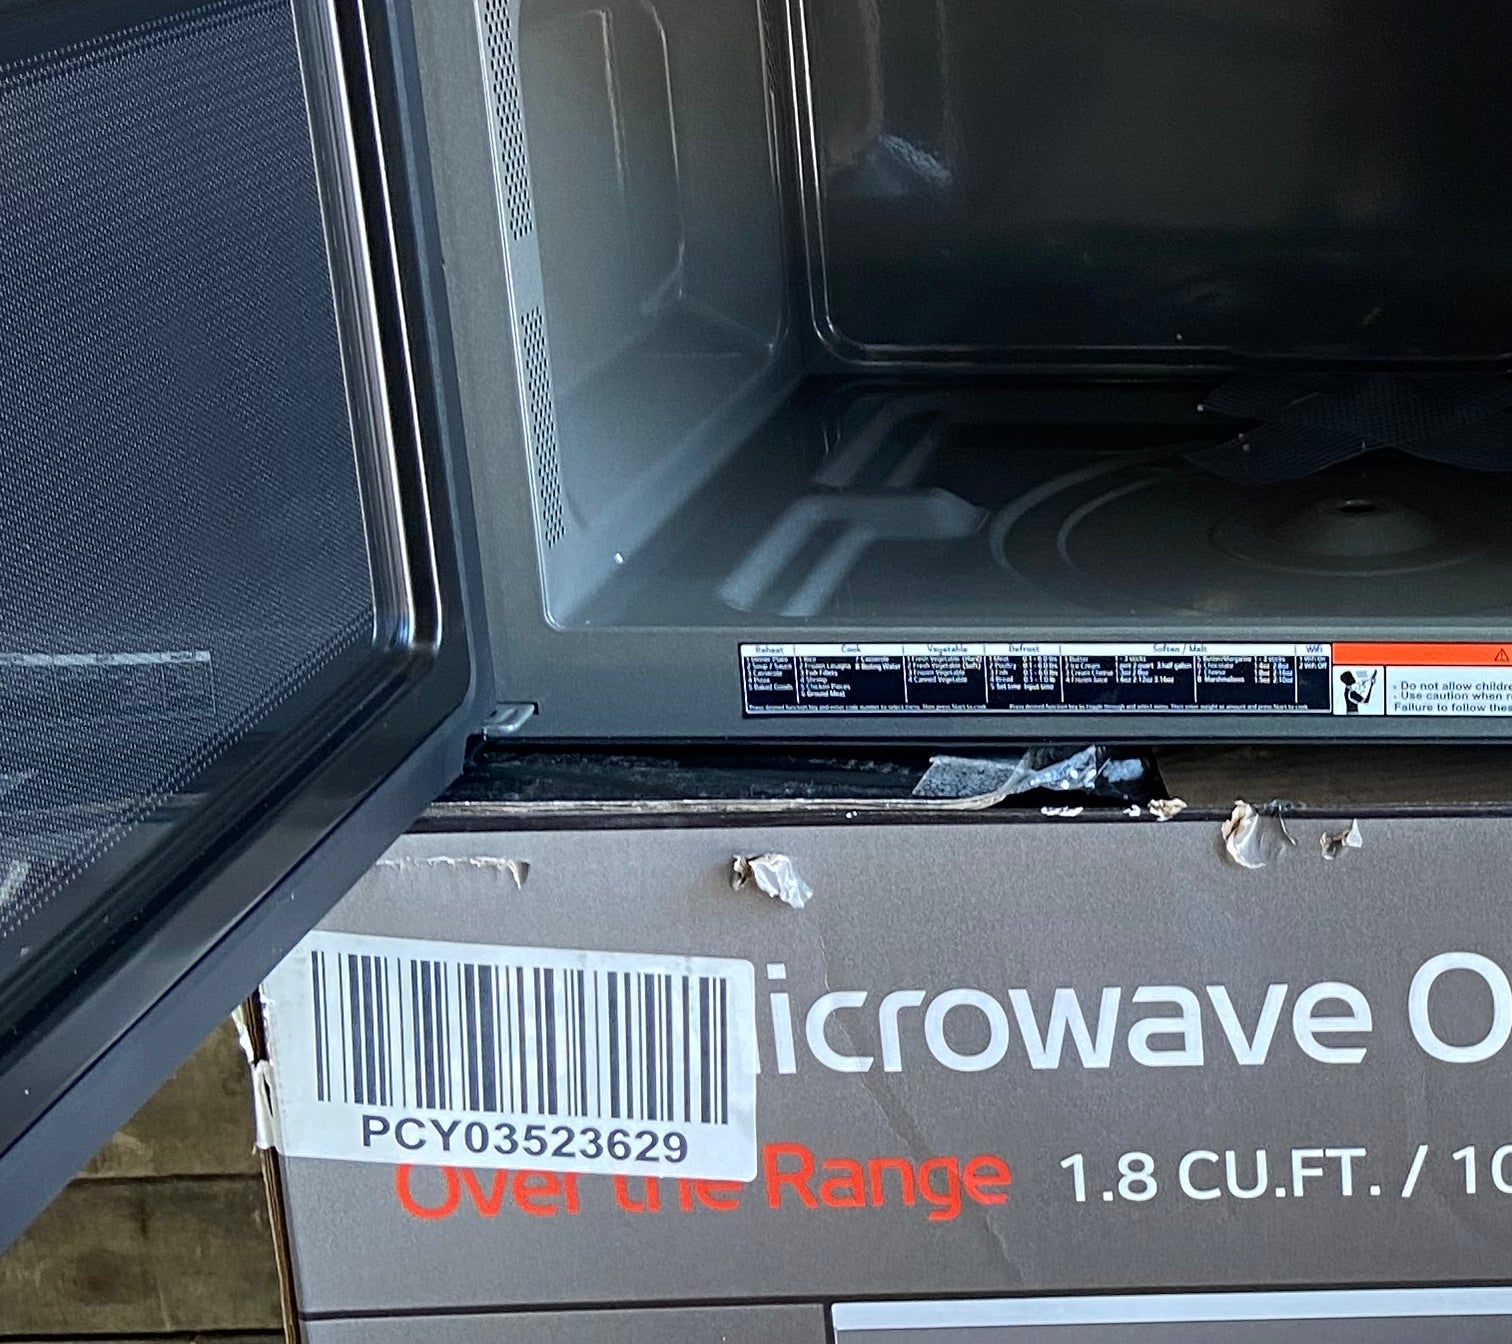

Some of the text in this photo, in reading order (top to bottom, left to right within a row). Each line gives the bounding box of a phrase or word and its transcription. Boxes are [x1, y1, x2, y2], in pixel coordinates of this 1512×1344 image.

[756, 645, 784, 654] Reheat
[841, 644, 861, 653] Cook
[1009, 644, 1040, 653] Defrost
[1153, 644, 1180, 653] Soften
[1401, 681, 1416, 690] Do
[1420, 682, 1438, 691] not
[1442, 682, 1472, 691] allow
[1401, 691, 1422, 700] Use
[1426, 691, 1468, 700] caution
[1472, 692, 1502, 700] when
[1394, 703, 1433, 712] Failure
[1437, 703, 1448, 712] to
[1451, 703, 1486, 712] follow
[755, 963, 1373, 1074] icrowave
[361, 1113, 688, 1164] PCY03523629
[395, 1163, 580, 1221] Over
[761, 1142, 1013, 1222] Range
[1060, 1152, 1158, 1203] 1.8
[1178, 1146, 1381, 1201] CU.FT.
[1401, 1144, 1428, 1199] /
